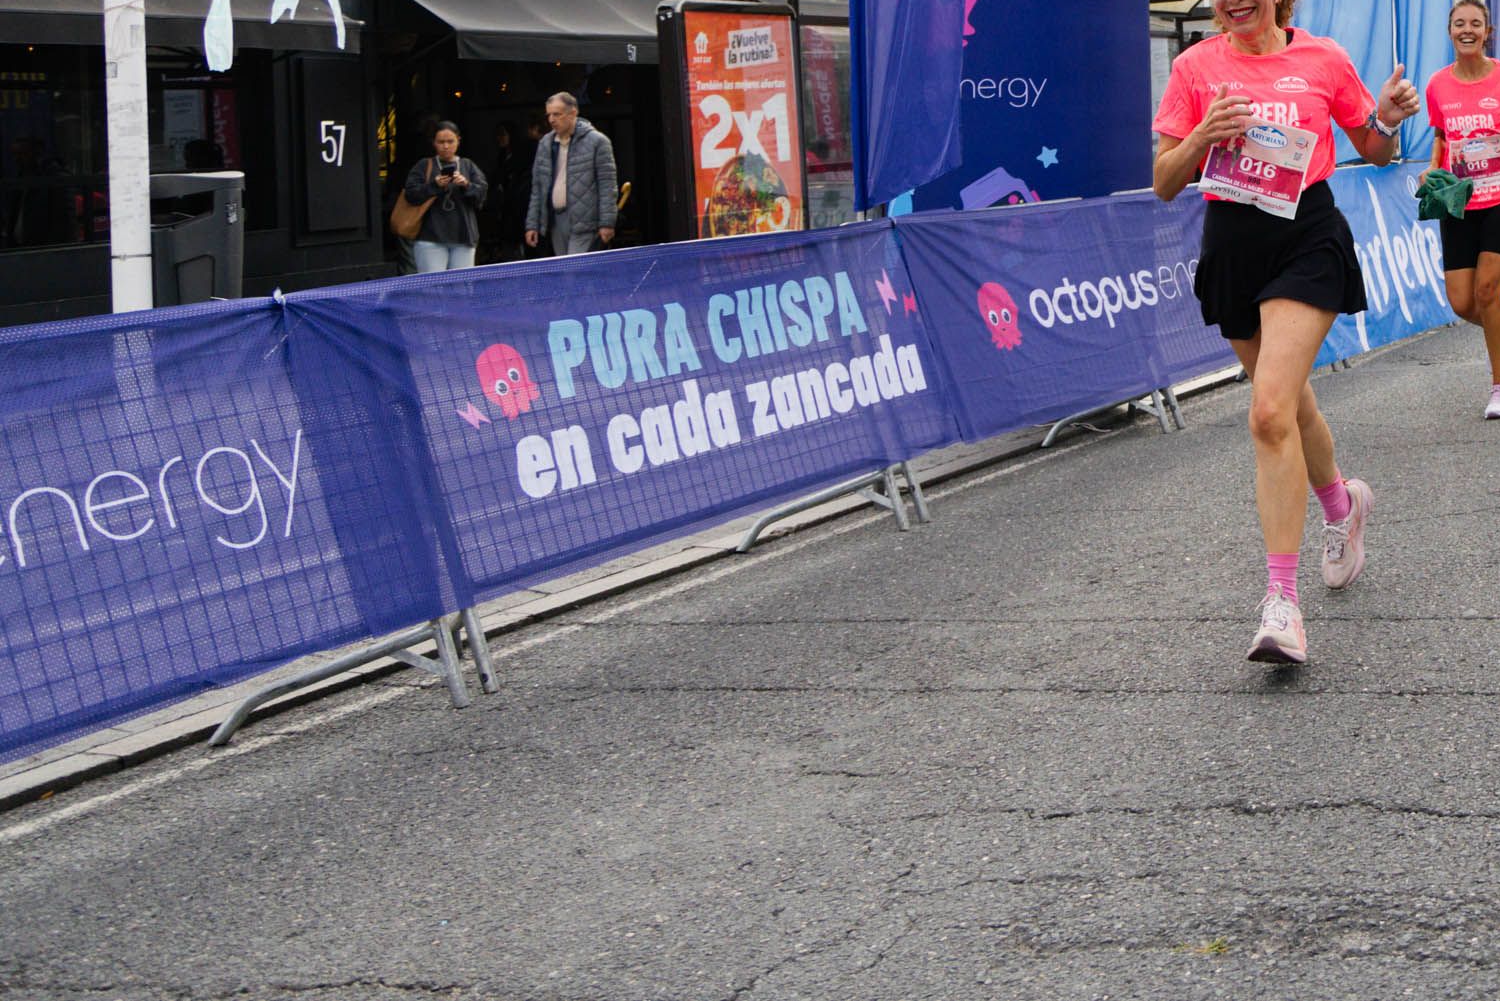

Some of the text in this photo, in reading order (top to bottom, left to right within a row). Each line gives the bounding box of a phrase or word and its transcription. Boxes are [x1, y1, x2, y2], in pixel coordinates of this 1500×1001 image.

[728, 44, 774, 64] la rutina?
[732, 31, 769, 48] ¿Vuelve
[960, 76, 1047, 108] nergy
[699, 92, 791, 168] 2x1
[1446, 114, 1496, 132] CARRERA
[320, 120, 346, 167] 57
[1239, 157, 1277, 179] 016
[1467, 159, 1489, 171] 016
[1029, 269, 1158, 329] octopus
[547, 271, 868, 400] PURA CHISPA
[515, 335, 927, 500] en cada zancada
[0, 429, 302, 567] nergy
